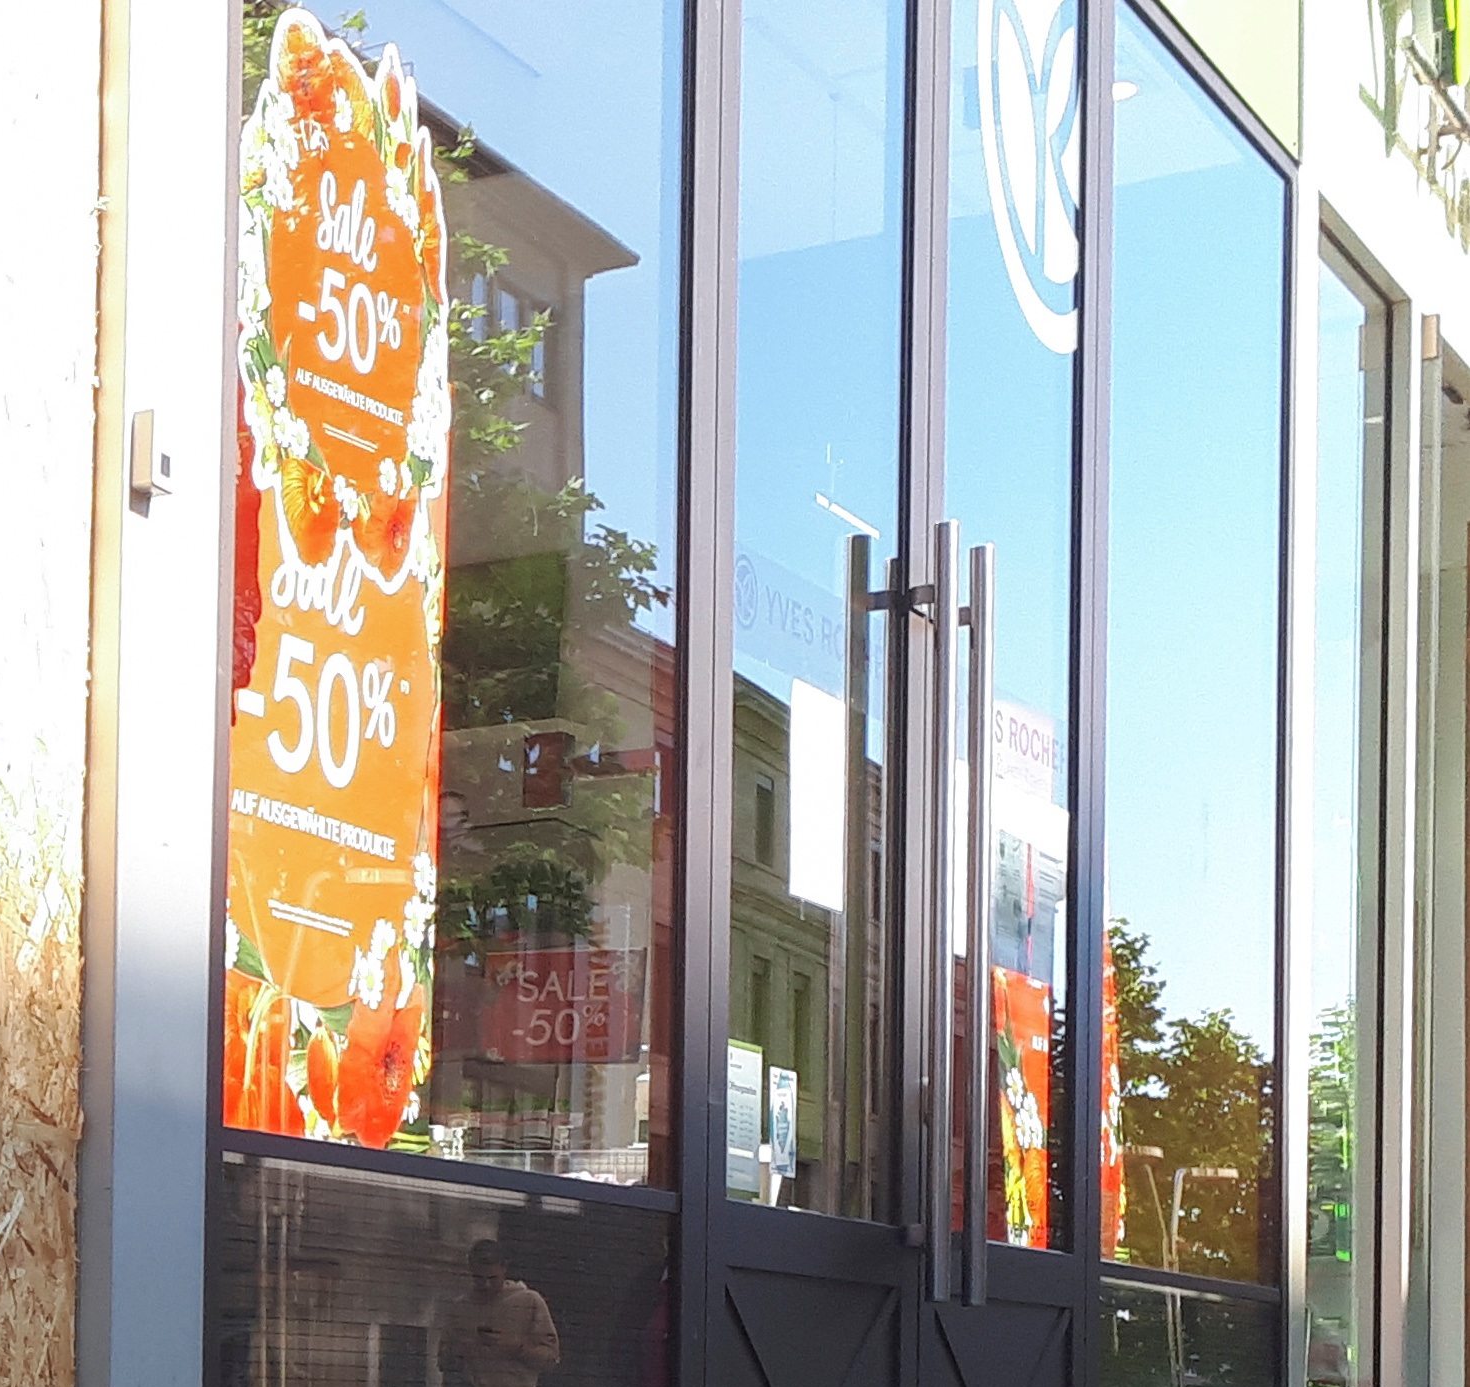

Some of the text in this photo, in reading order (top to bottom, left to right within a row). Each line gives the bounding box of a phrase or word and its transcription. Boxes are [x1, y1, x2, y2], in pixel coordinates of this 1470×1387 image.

[318, 171, 377, 271] Sale
[295, 367, 404, 426] AUF AUSGEWÄHLTE PRODUKTE
[765, 585, 814, 646] YVES
[232, 788, 396, 861] AUF AUSGEWÄHLTE PRODUKTE
[517, 970, 609, 1002] SALE
